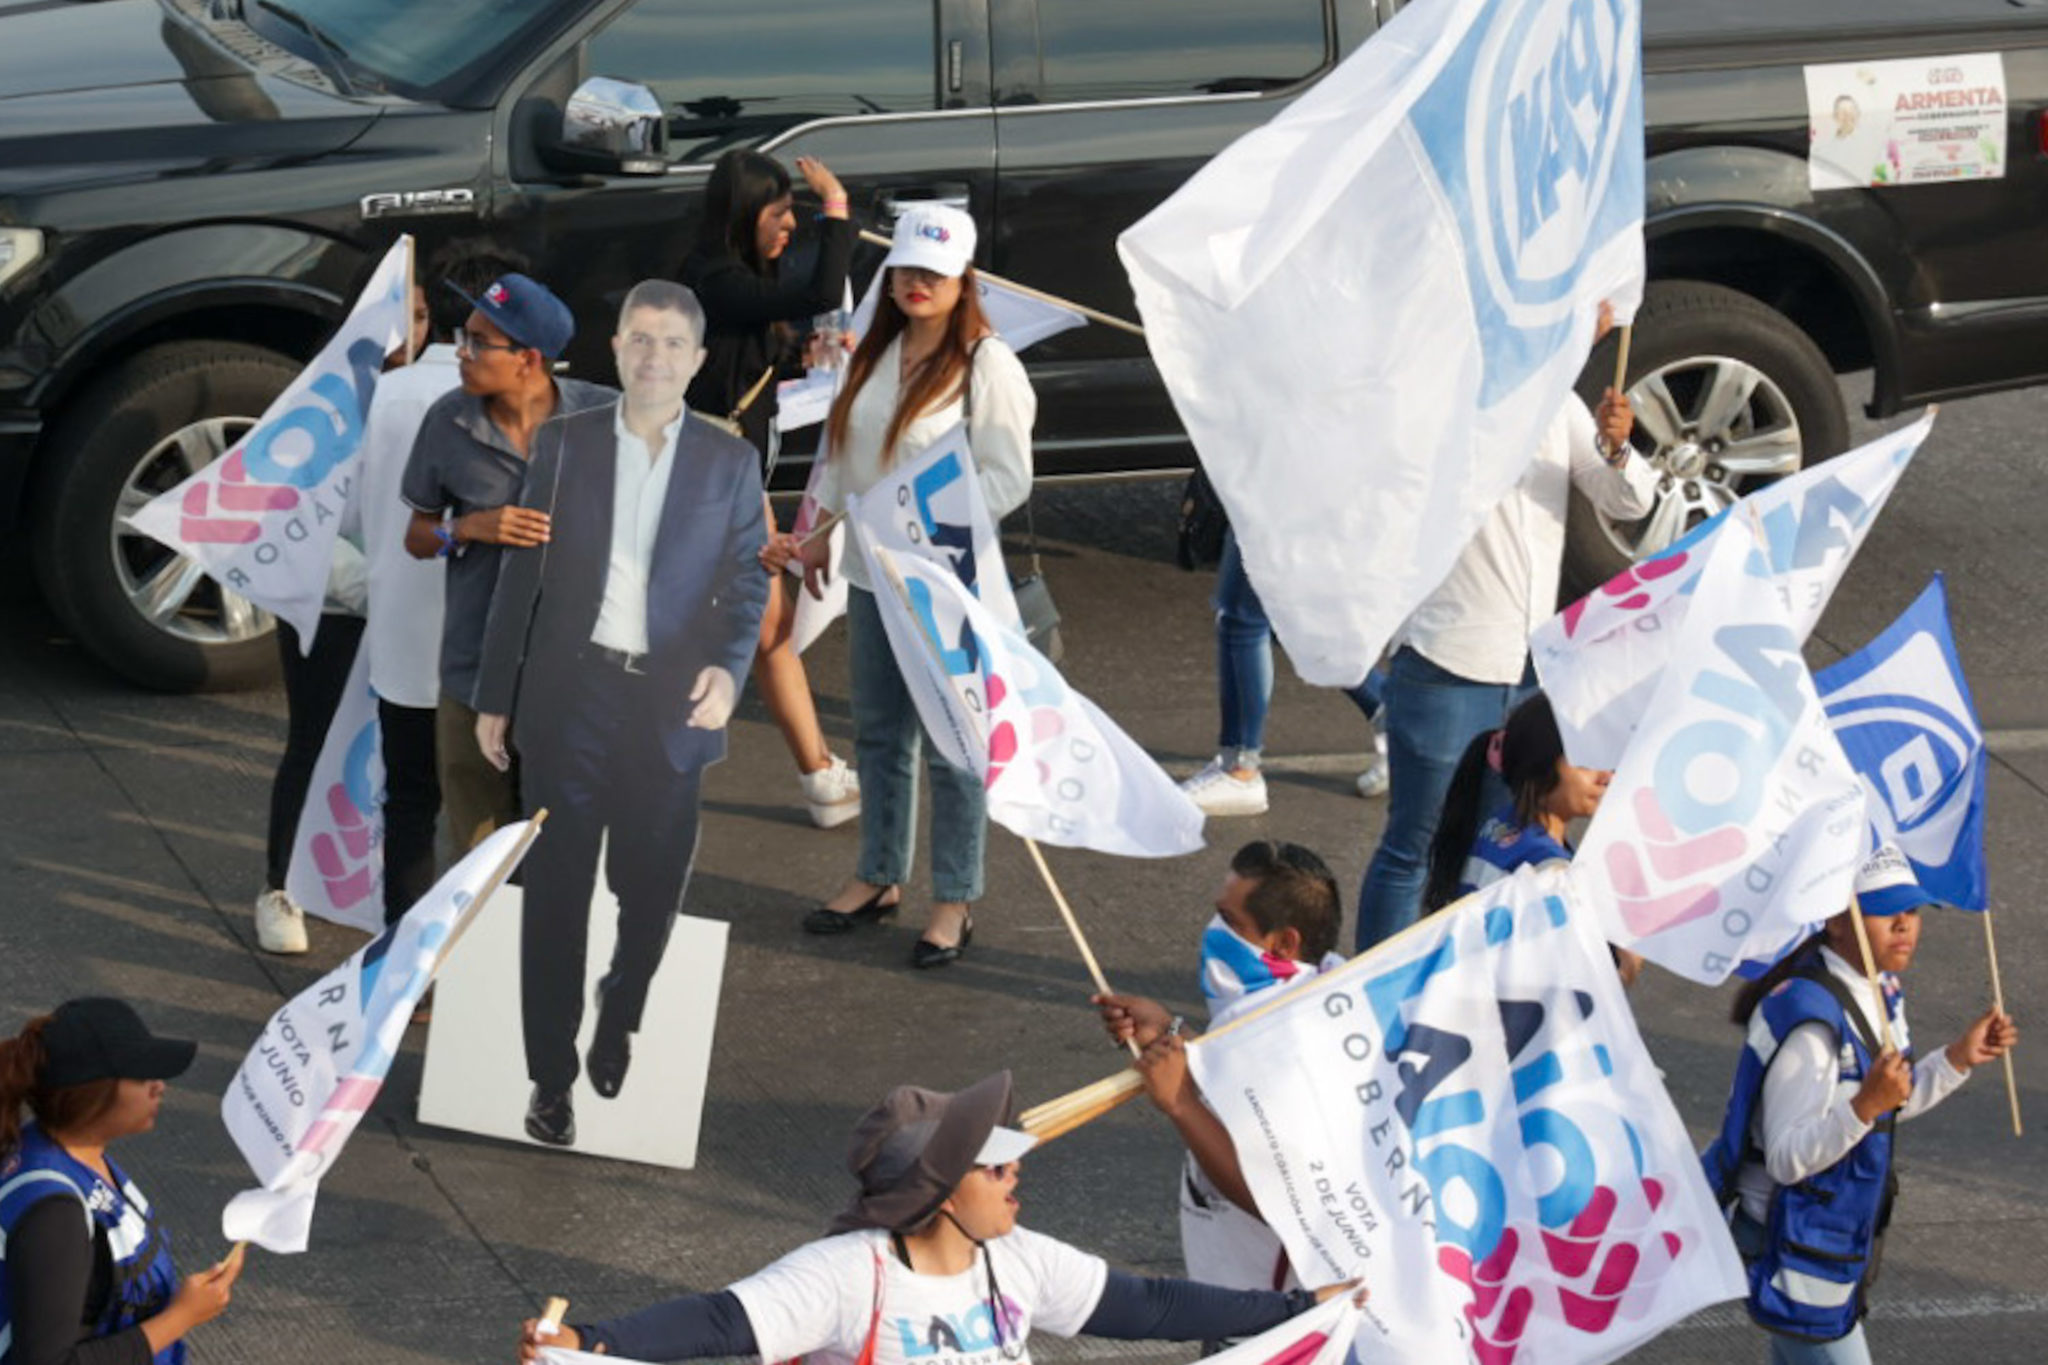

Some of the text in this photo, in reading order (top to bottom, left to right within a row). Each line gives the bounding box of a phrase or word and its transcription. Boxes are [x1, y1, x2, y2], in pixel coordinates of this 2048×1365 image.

[1895, 86, 2003, 112] ARMENTA
[277, 1007, 311, 1068] VOTA
[260, 1045, 305, 1108] JUNIO
[1309, 1160, 1371, 1259] 2 DE JUNIO
[1345, 1182, 1378, 1233] VOTA
